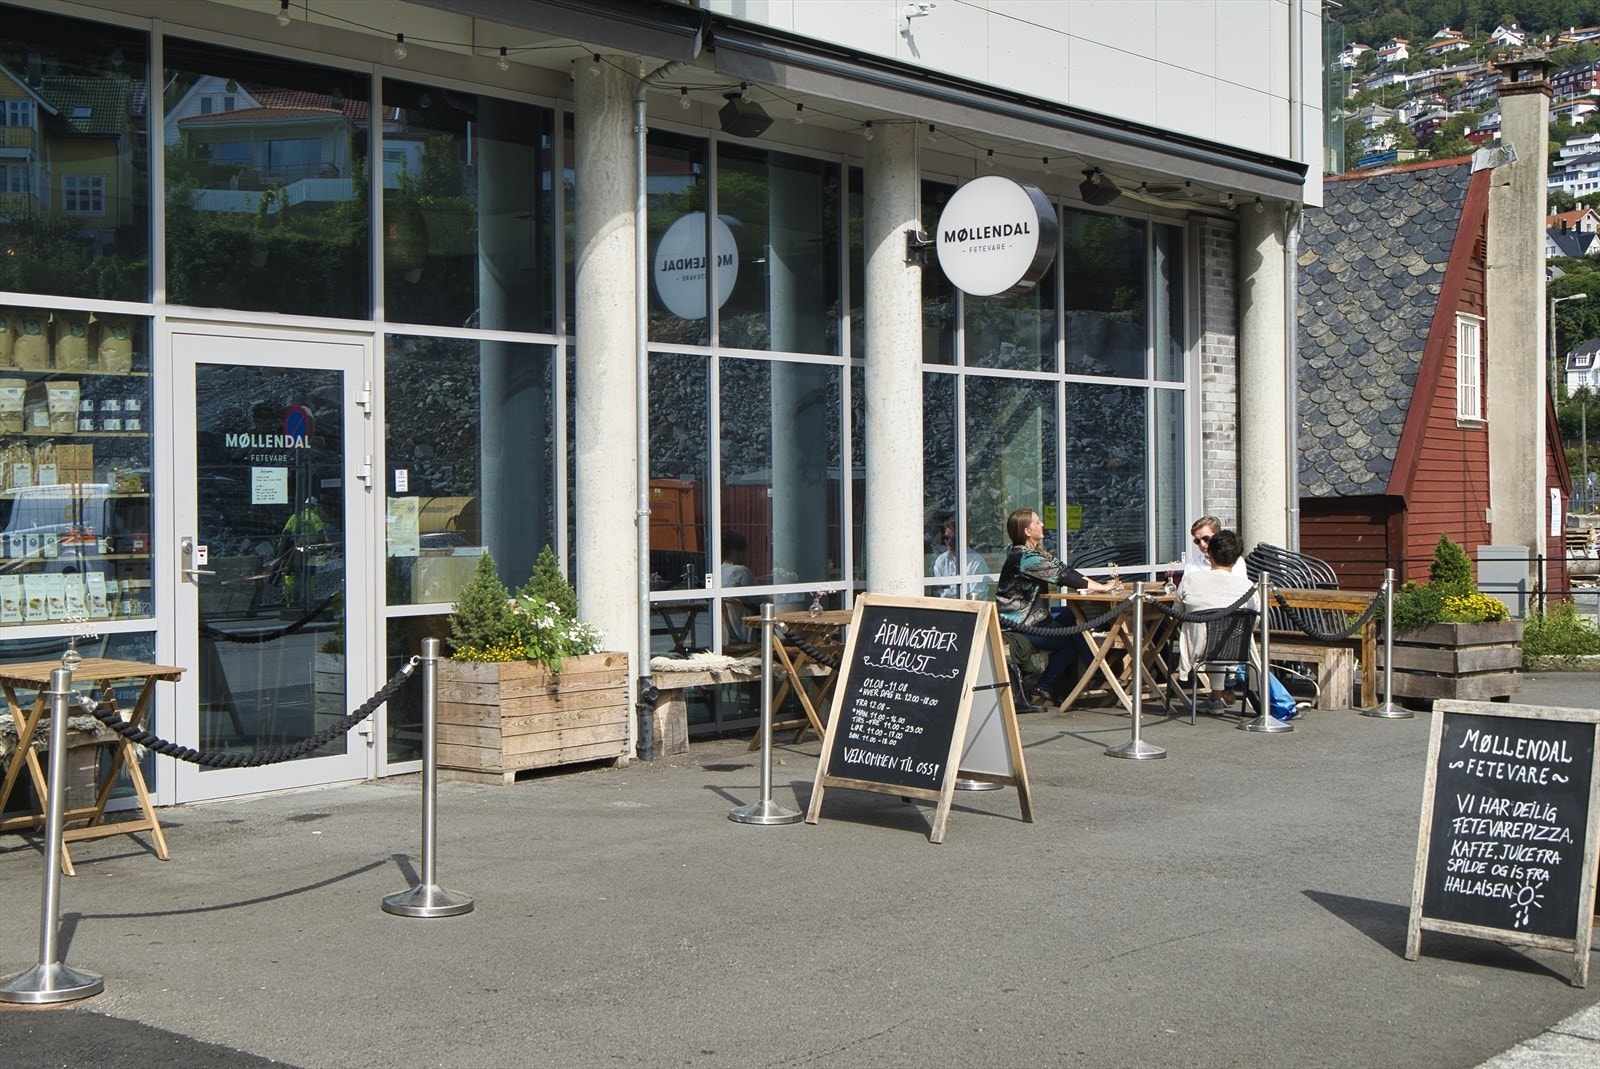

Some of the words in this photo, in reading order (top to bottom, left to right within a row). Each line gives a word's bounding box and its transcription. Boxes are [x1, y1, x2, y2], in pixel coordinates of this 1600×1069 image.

[944, 222, 1030, 243] MØLLENDAL
[969, 243, 1006, 253] FETEVARE
[225, 433, 311, 448] MØLLENDAL
[250, 454, 287, 462] FETEVARE
[874, 618, 958, 651] ÅPNINGSTIDER
[880, 648, 936, 672] AUGUST
[855, 698, 868, 707] FRA
[863, 688, 879, 697] HVER
[880, 689, 894, 699] DAG
[1459, 728, 1573, 764] MØLLENDAL
[843, 746, 899, 769] VELKOMMEN
[900, 756, 914, 773] TIL
[915, 761, 940, 781] OSS!
[1466, 758, 1550, 785] FETEVARE
[1456, 793, 1476, 814] VI
[1479, 796, 1510, 817] HAR
[1512, 800, 1558, 824] DEILIG
[1450, 839, 1498, 860] KAFFE,
[1500, 844, 1538, 862] JUICE
[1536, 849, 1562, 865] FRA
[1447, 857, 1488, 874] SPILDE
[1491, 864, 1509, 877] OG
[1510, 864, 1524, 879] IS
[1526, 867, 1550, 882] FRA
[1444, 875, 1514, 899] HALLAISEN
